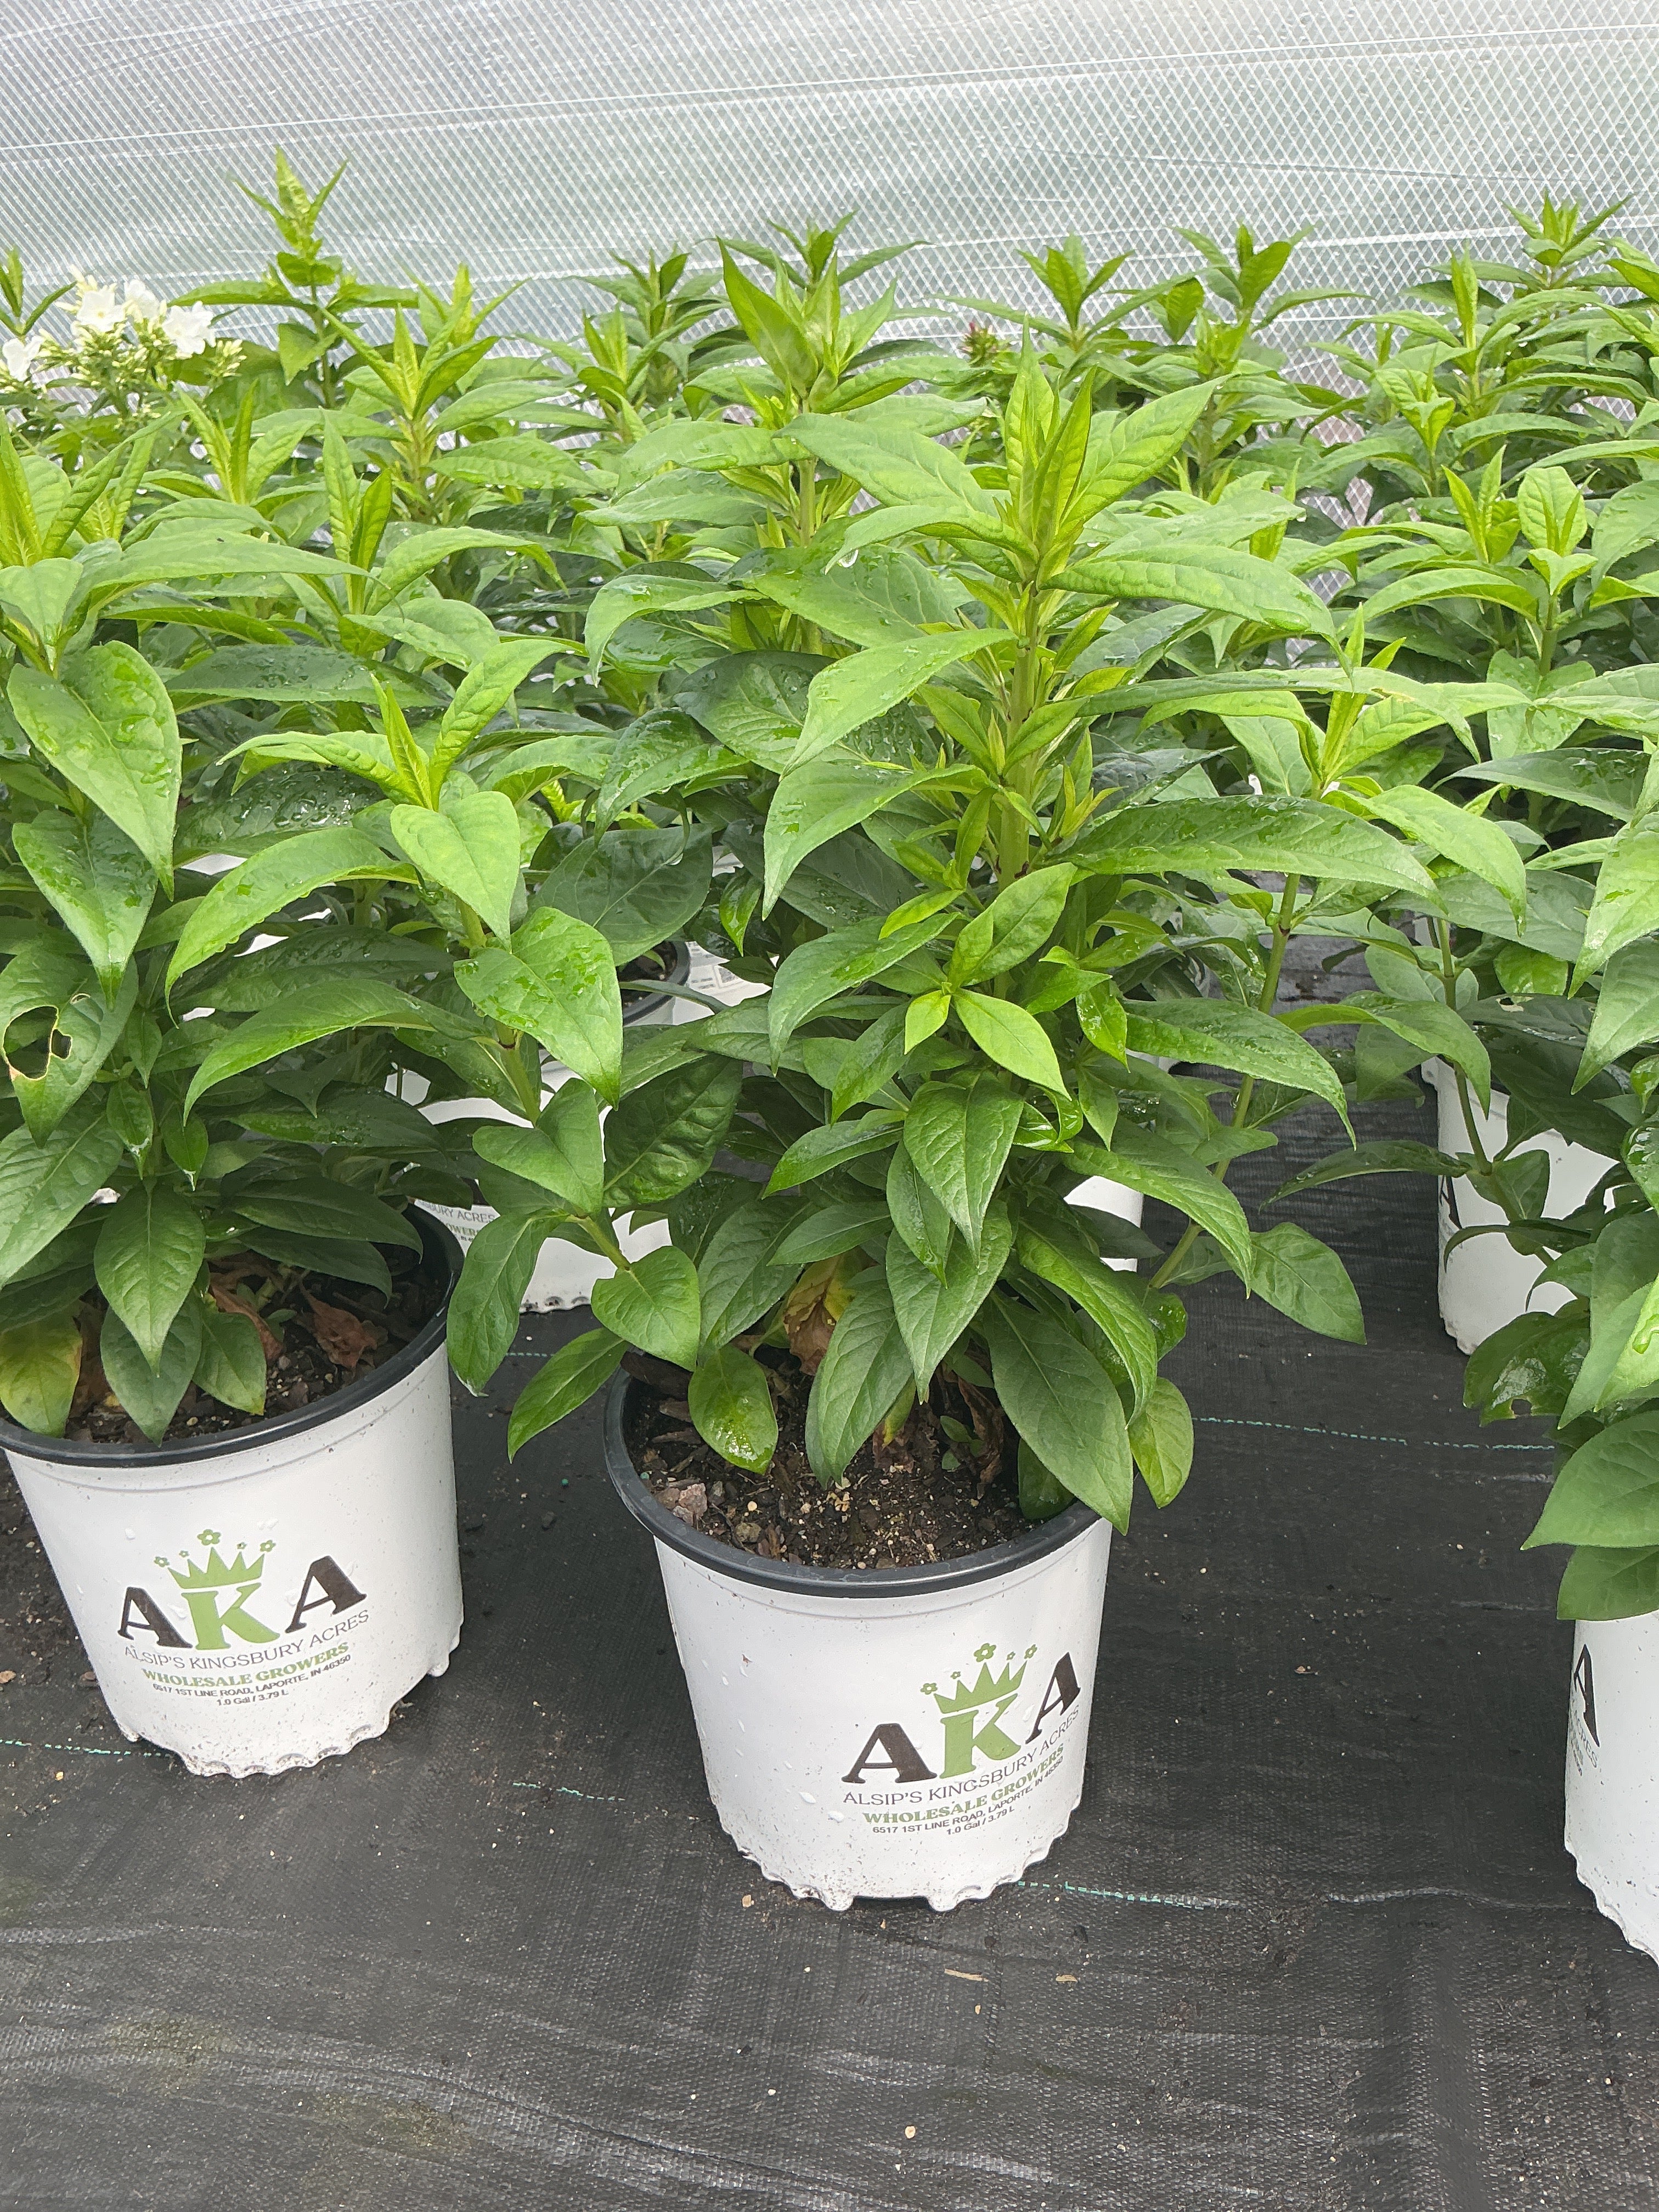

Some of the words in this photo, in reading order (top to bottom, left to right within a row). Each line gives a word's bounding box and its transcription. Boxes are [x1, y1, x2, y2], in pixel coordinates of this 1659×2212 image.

[117, 1555, 367, 1650] AKA
[125, 1644, 185, 1669] ALSIP'S
[190, 1639, 303, 1669] KINGSBURY
[309, 1610, 369, 1648] ACRES
[141, 1668, 252, 1687] WHOLESALE
[256, 1642, 349, 1681] GROWERS
[153, 1683, 172, 1694] 6517
[311, 1667, 321, 1677] IN
[323, 1654, 351, 1672] 46350
[233, 1696, 251, 1705] Gal
[258, 1690, 279, 1701] 3.79
[841, 1651, 1081, 1784] AKA
[843, 1791, 923, 1805] ALSIP'S
[929, 1747, 1037, 1801] KINGSBURY
[1040, 1705, 1079, 1756] ACRES
[862, 1795, 988, 1824] WHOLESALE
[991, 1743, 1064, 1801] GROWERS
[901, 1824, 922, 1833] 1ST
[924, 1819, 950, 1830] LINE
[1035, 1776, 1043, 1787] IN
[946, 1826, 961, 1835] 1.0
[964, 1819, 980, 1831] Gal
[988, 1808, 1007, 1823] 3.79
